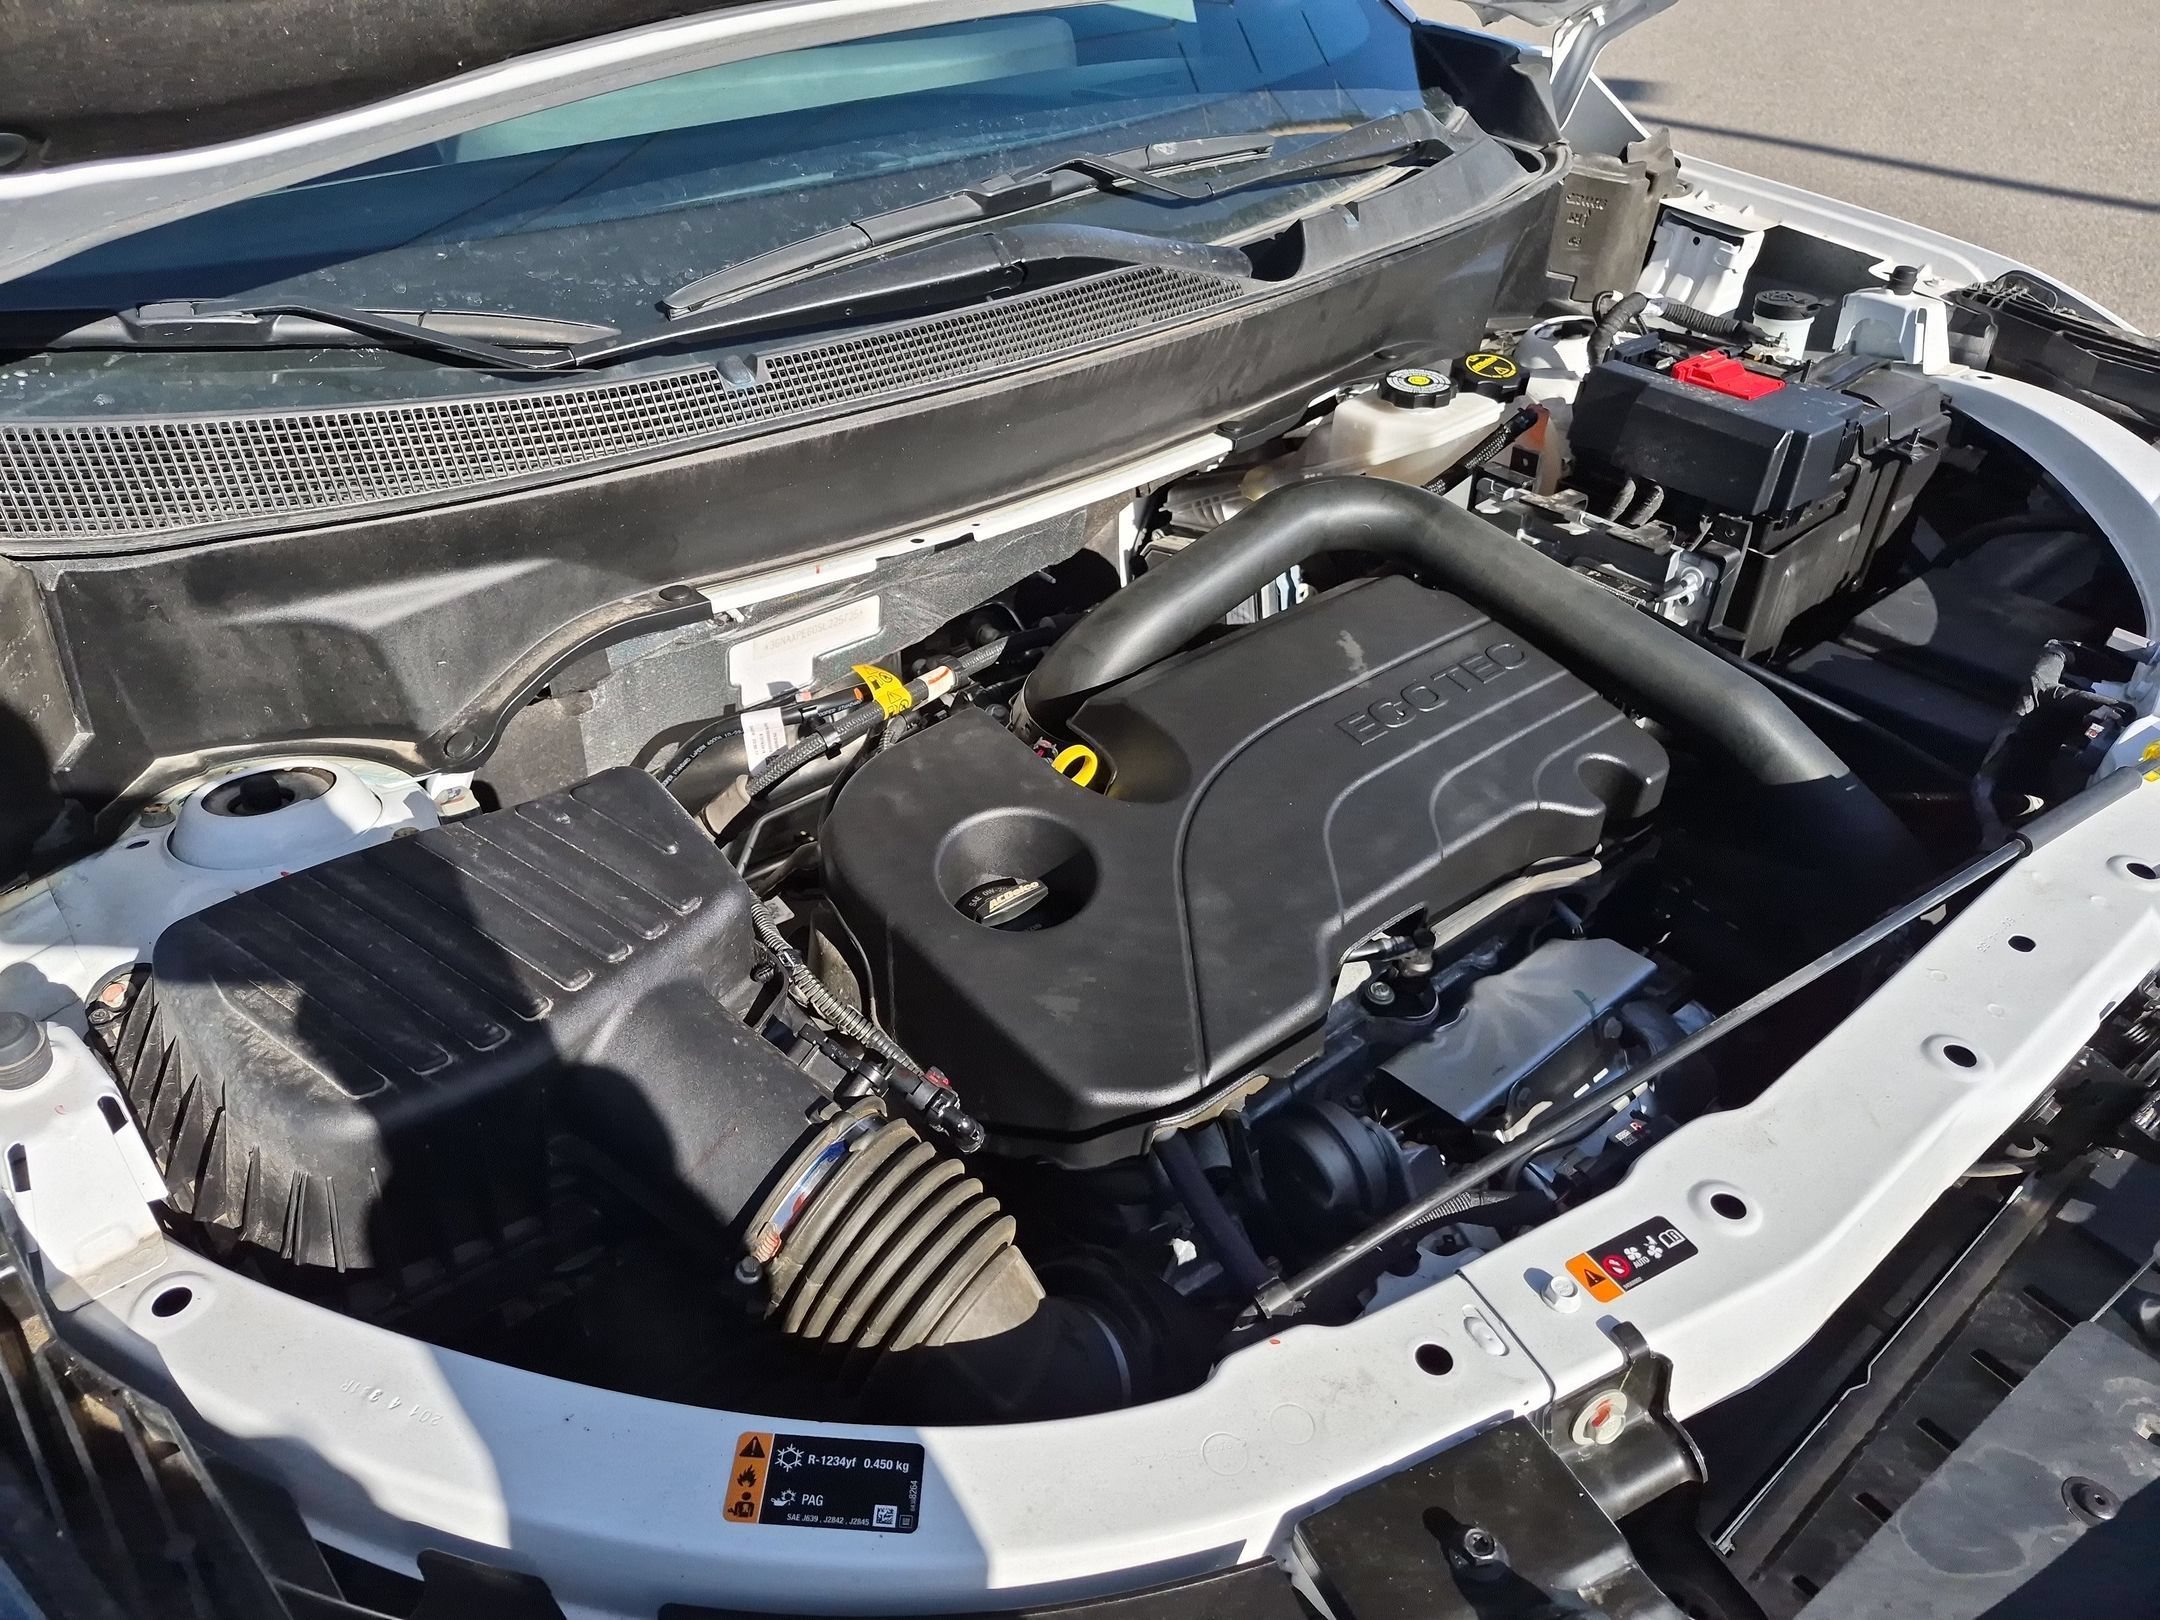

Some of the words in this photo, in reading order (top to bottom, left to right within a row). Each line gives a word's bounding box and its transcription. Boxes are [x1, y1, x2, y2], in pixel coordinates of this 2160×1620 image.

[968, 895, 982, 907] SAE
[989, 881, 1039, 908] ACDelco
[1633, 1256, 1650, 1269] AUTO
[807, 1454, 857, 1468] R-1234yf
[863, 1460, 893, 1470] 0.450
[895, 1461, 909, 1473] kg
[801, 1493, 824, 1507] PAG
[786, 1512, 801, 1522] SAE
[823, 1515, 844, 1525] J2842
